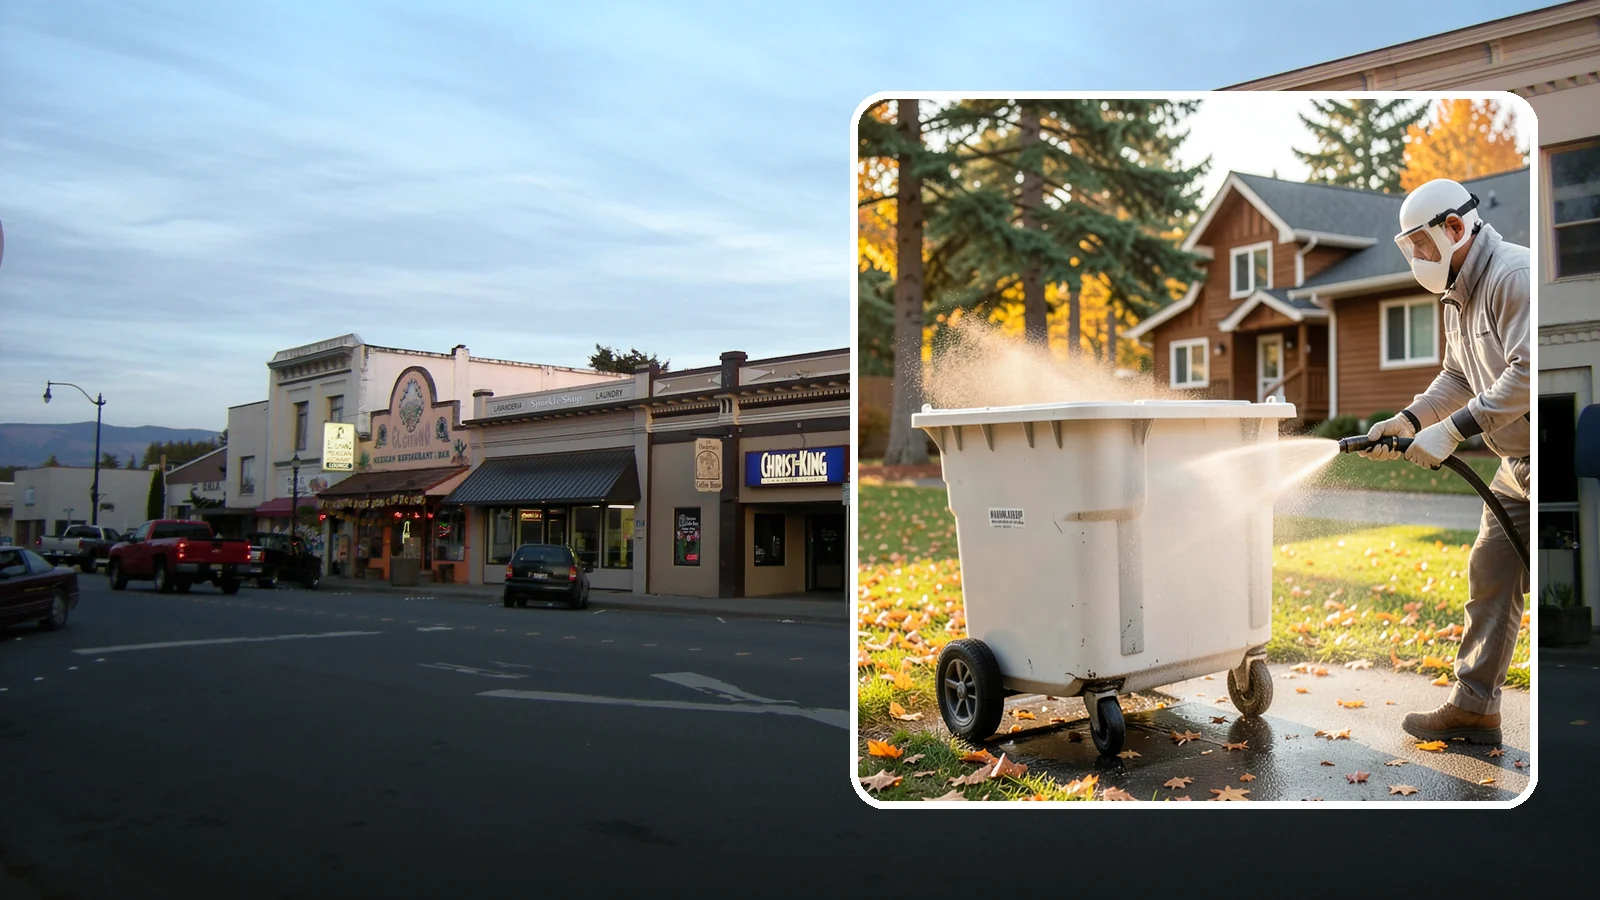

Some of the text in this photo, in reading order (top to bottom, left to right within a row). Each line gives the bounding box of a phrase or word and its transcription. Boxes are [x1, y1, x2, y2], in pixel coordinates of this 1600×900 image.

[562, 394, 582, 404] Shop
[595, 389, 623, 400] LAUNDRY
[374, 450, 450, 464] MEXICAN RESTAURANT BAR
[761, 449, 827, 478] CHRIST KING
